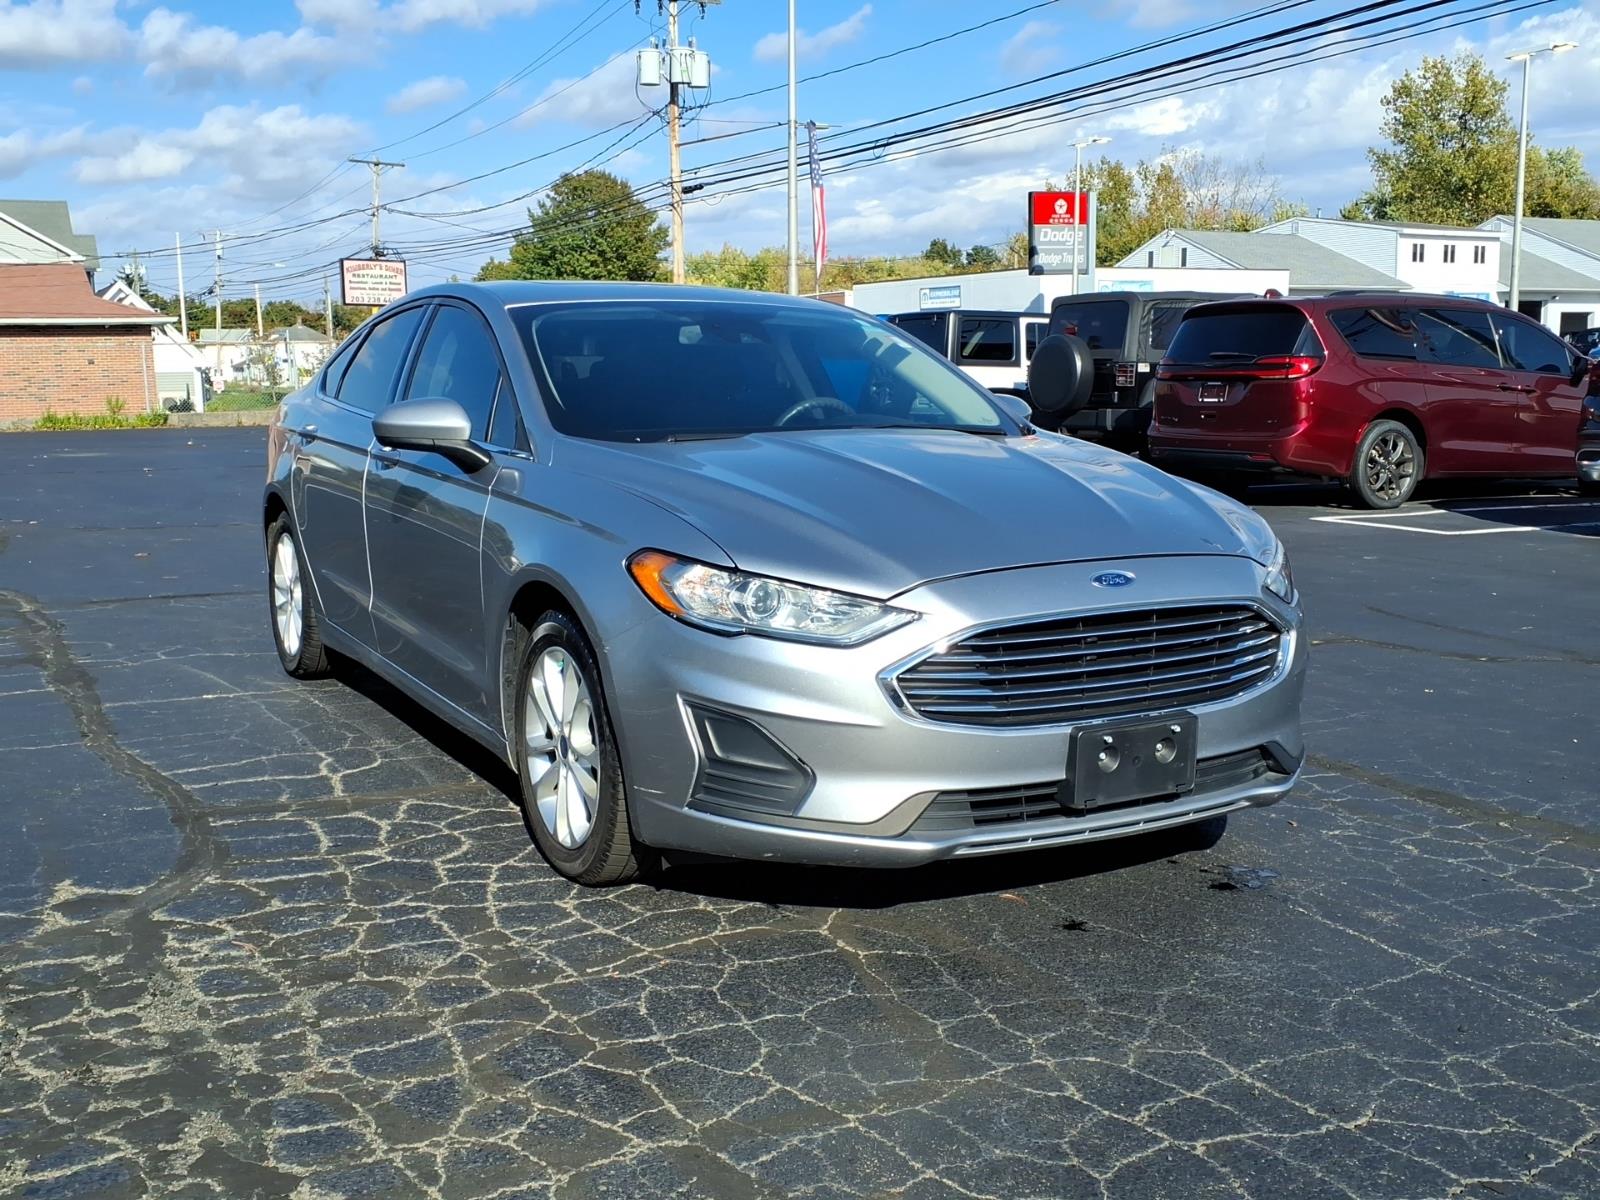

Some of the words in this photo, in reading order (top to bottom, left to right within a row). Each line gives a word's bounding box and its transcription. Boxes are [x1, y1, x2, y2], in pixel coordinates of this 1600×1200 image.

[1040, 228, 1083, 245] Dodge
[1039, 253, 1062, 266] Dodge
[1062, 252, 1084, 264] Trus
[1101, 574, 1126, 585] Ford
